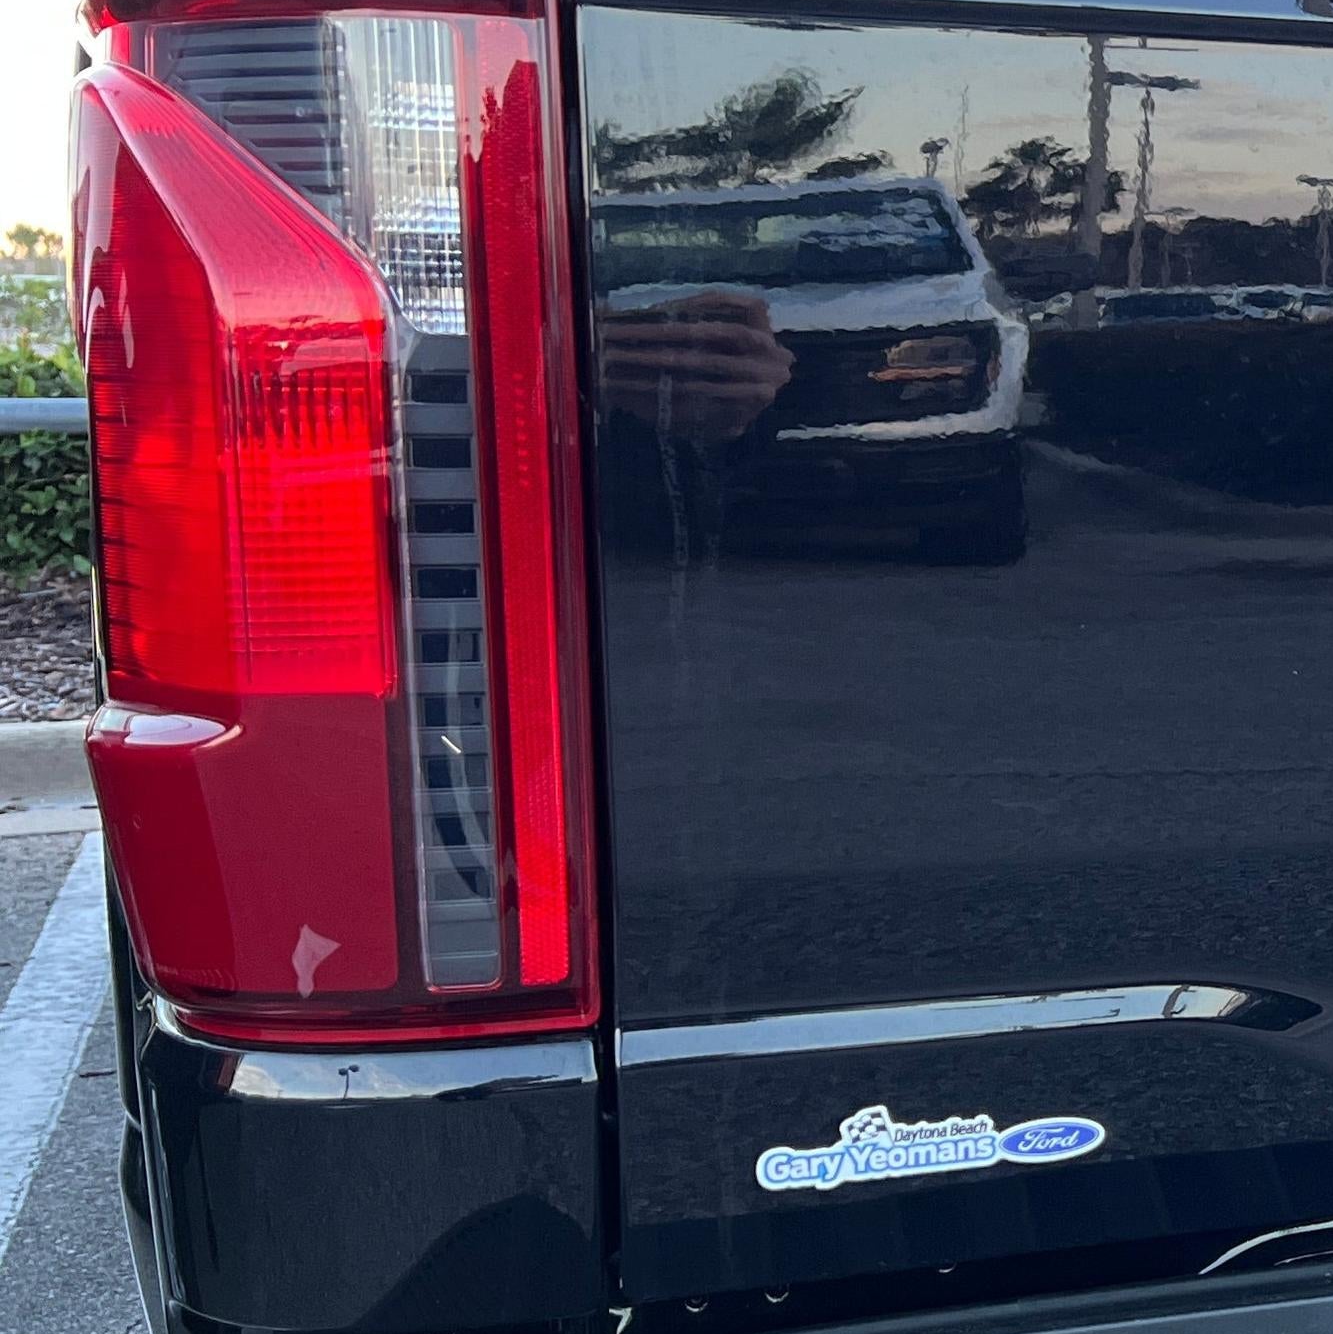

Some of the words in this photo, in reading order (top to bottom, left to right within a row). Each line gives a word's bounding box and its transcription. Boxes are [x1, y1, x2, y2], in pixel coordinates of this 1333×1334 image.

[894, 1126, 948, 1143] Daytona
[949, 1119, 988, 1137] Beach
[1016, 1126, 1080, 1153] Ford
[764, 1151, 846, 1184] Gary
[845, 1135, 997, 1174] Yeomans
